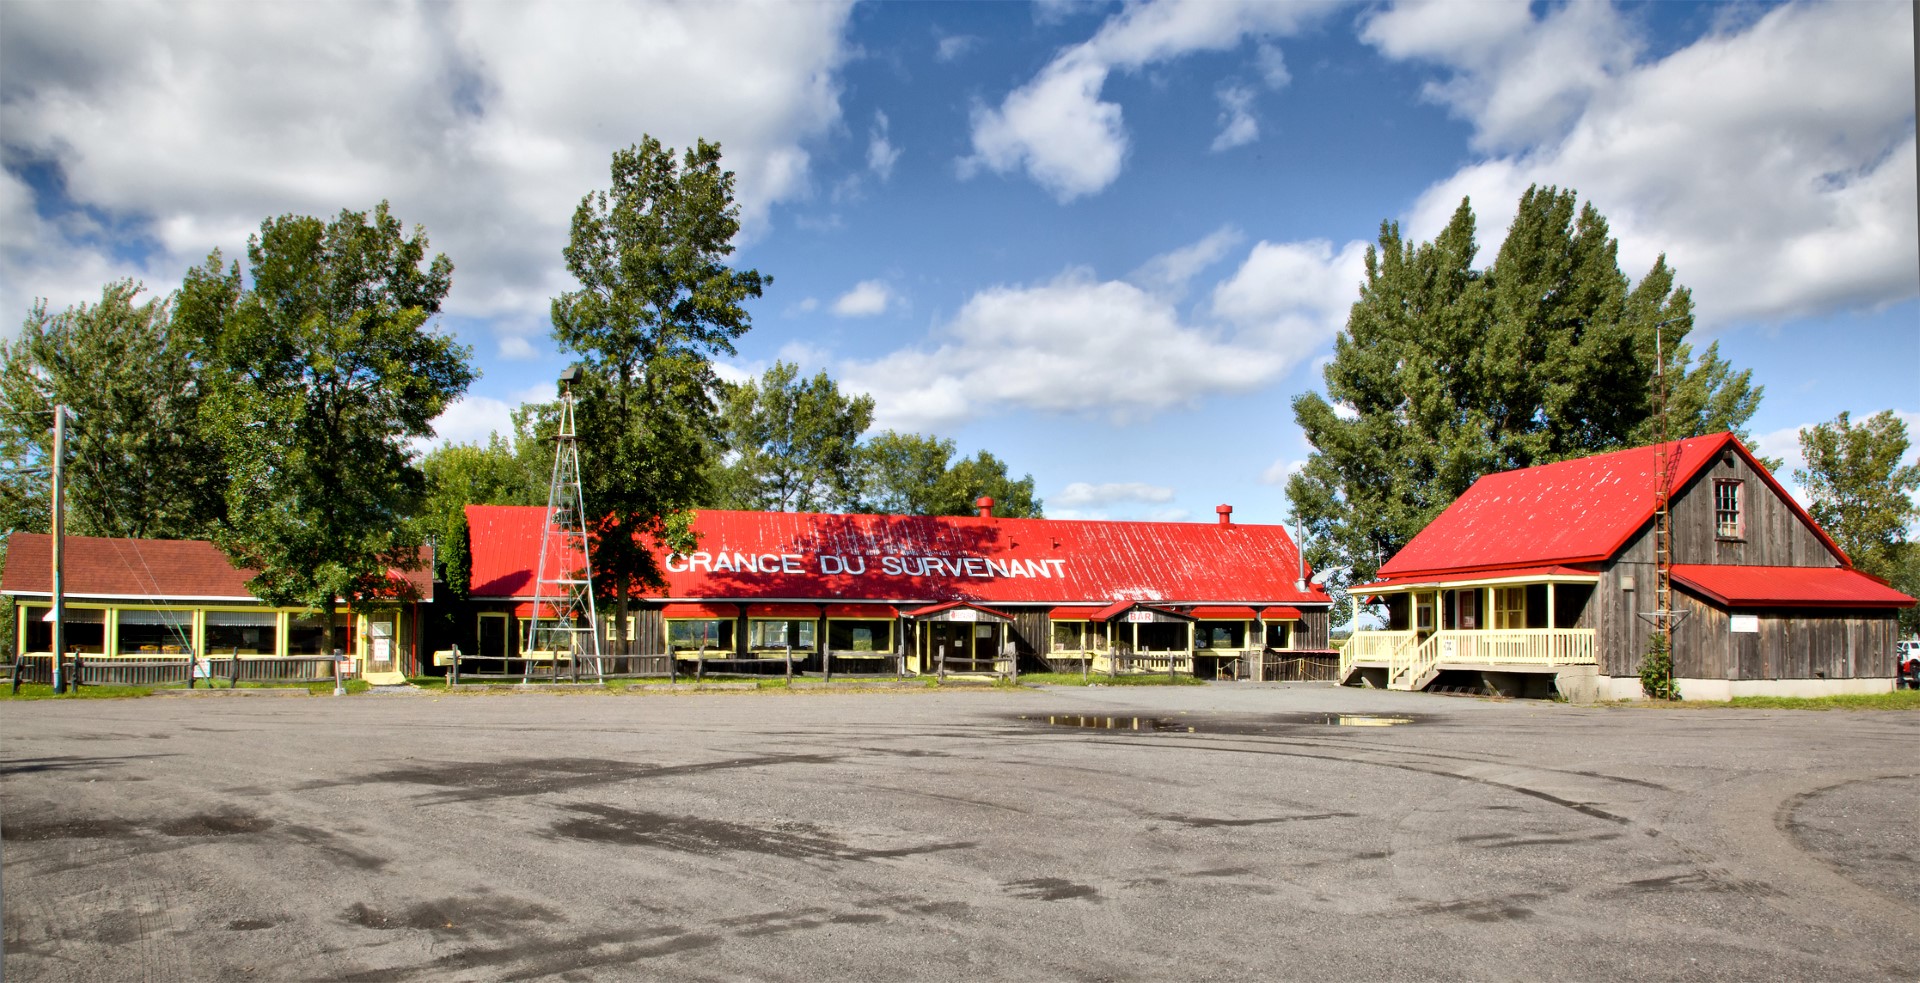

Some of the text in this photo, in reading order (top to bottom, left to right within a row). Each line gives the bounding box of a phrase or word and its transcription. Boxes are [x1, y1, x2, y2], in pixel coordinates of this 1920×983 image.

[665, 551, 1066, 579] GRANGE DU SURVENANT
[1129, 612, 1152, 621] BAR
